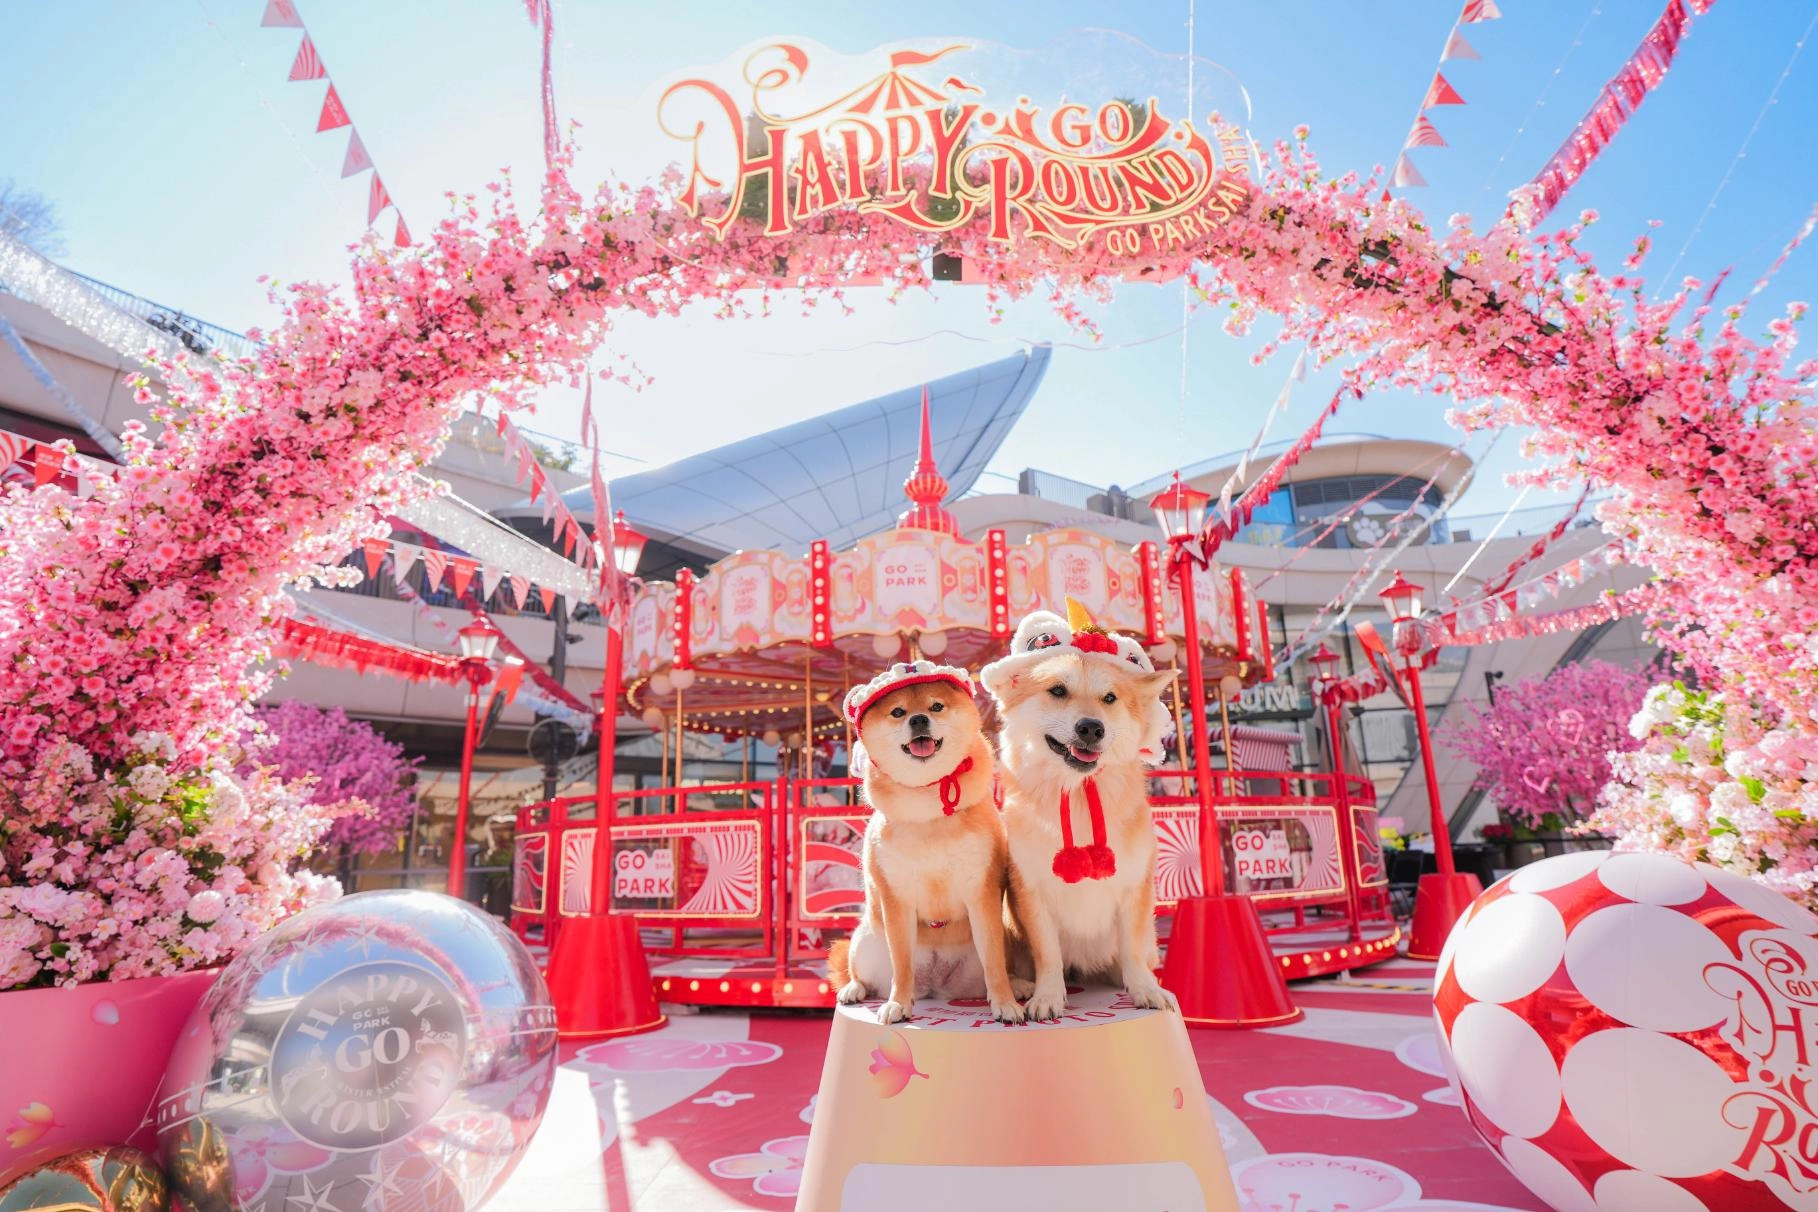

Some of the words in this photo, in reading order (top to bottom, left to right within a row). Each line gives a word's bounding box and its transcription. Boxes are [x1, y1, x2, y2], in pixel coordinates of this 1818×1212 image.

[1051, 100, 1134, 149] GO
[658, 78, 979, 240] HAPPY
[955, 142, 1213, 249] ROUND
[1106, 228, 1140, 255] GO
[1149, 206, 1218, 250] PARK
[1207, 180, 1248, 223] SAI
[885, 564, 908, 575] GO
[885, 576, 928, 588] PARK
[1235, 834, 1264, 851] GO
[618, 854, 646, 870] GO
[1239, 857, 1289, 877] PARK
[618, 878, 670, 894] PARK
[1785, 979, 1812, 998] GO
[297, 974, 443, 1041] HAPPY
[352, 1015, 391, 1031] PARK
[335, 1027, 411, 1073] GO
[1277, 1159, 1315, 1168] GO
[1326, 1160, 1394, 1183] PARK
